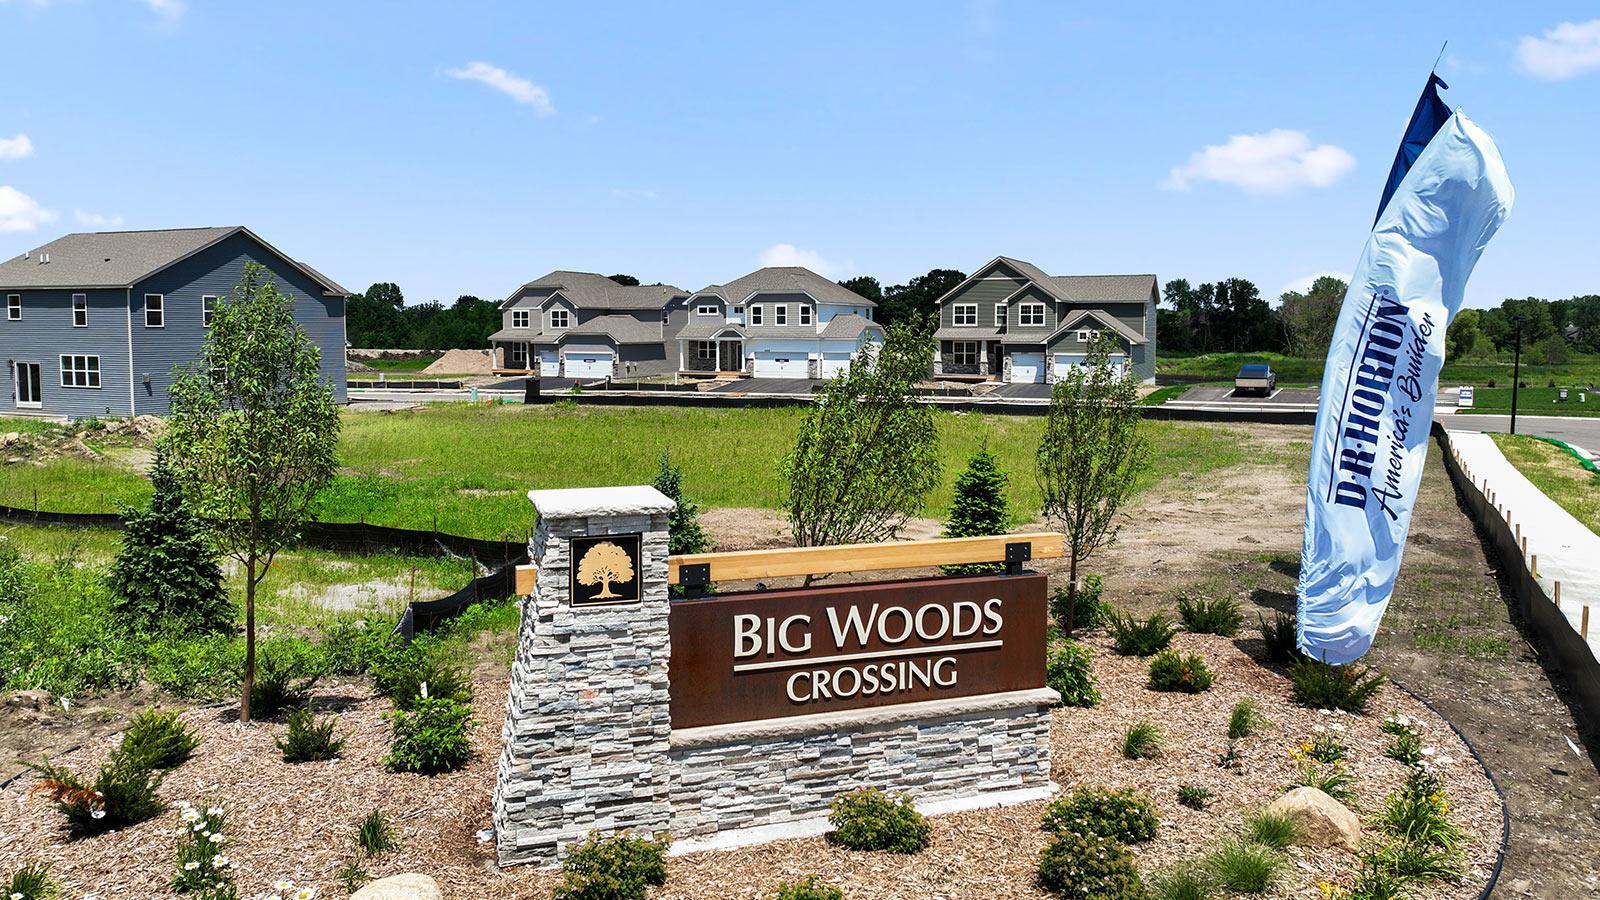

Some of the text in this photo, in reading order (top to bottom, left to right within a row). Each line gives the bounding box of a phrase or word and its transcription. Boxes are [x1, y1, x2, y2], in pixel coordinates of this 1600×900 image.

[1371, 311, 1436, 521] America's Builder
[733, 598, 1003, 657] BIG WOODS
[786, 657, 958, 702] CROSSING
